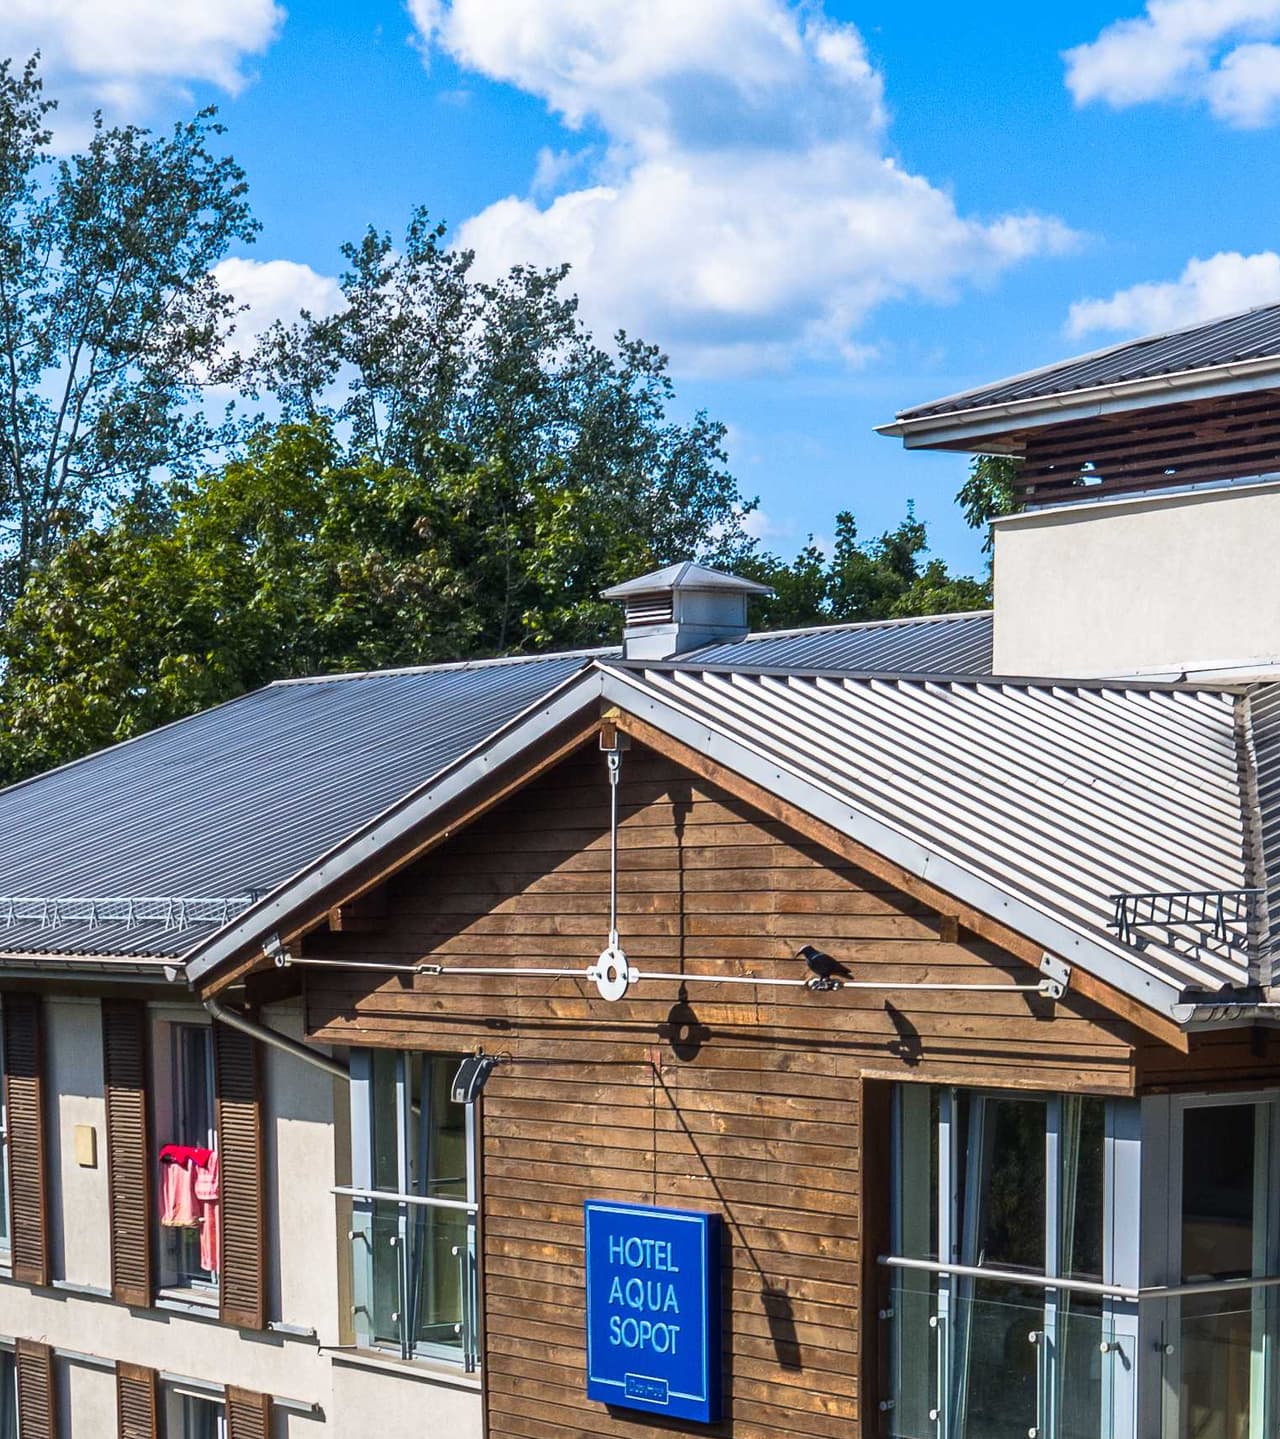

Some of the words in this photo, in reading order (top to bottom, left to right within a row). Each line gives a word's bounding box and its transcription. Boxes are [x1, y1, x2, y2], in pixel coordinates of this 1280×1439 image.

[608, 1234, 680, 1273] HOTEL
[608, 1275, 680, 1315] AQUA
[609, 1315, 681, 1355] SOPOT
